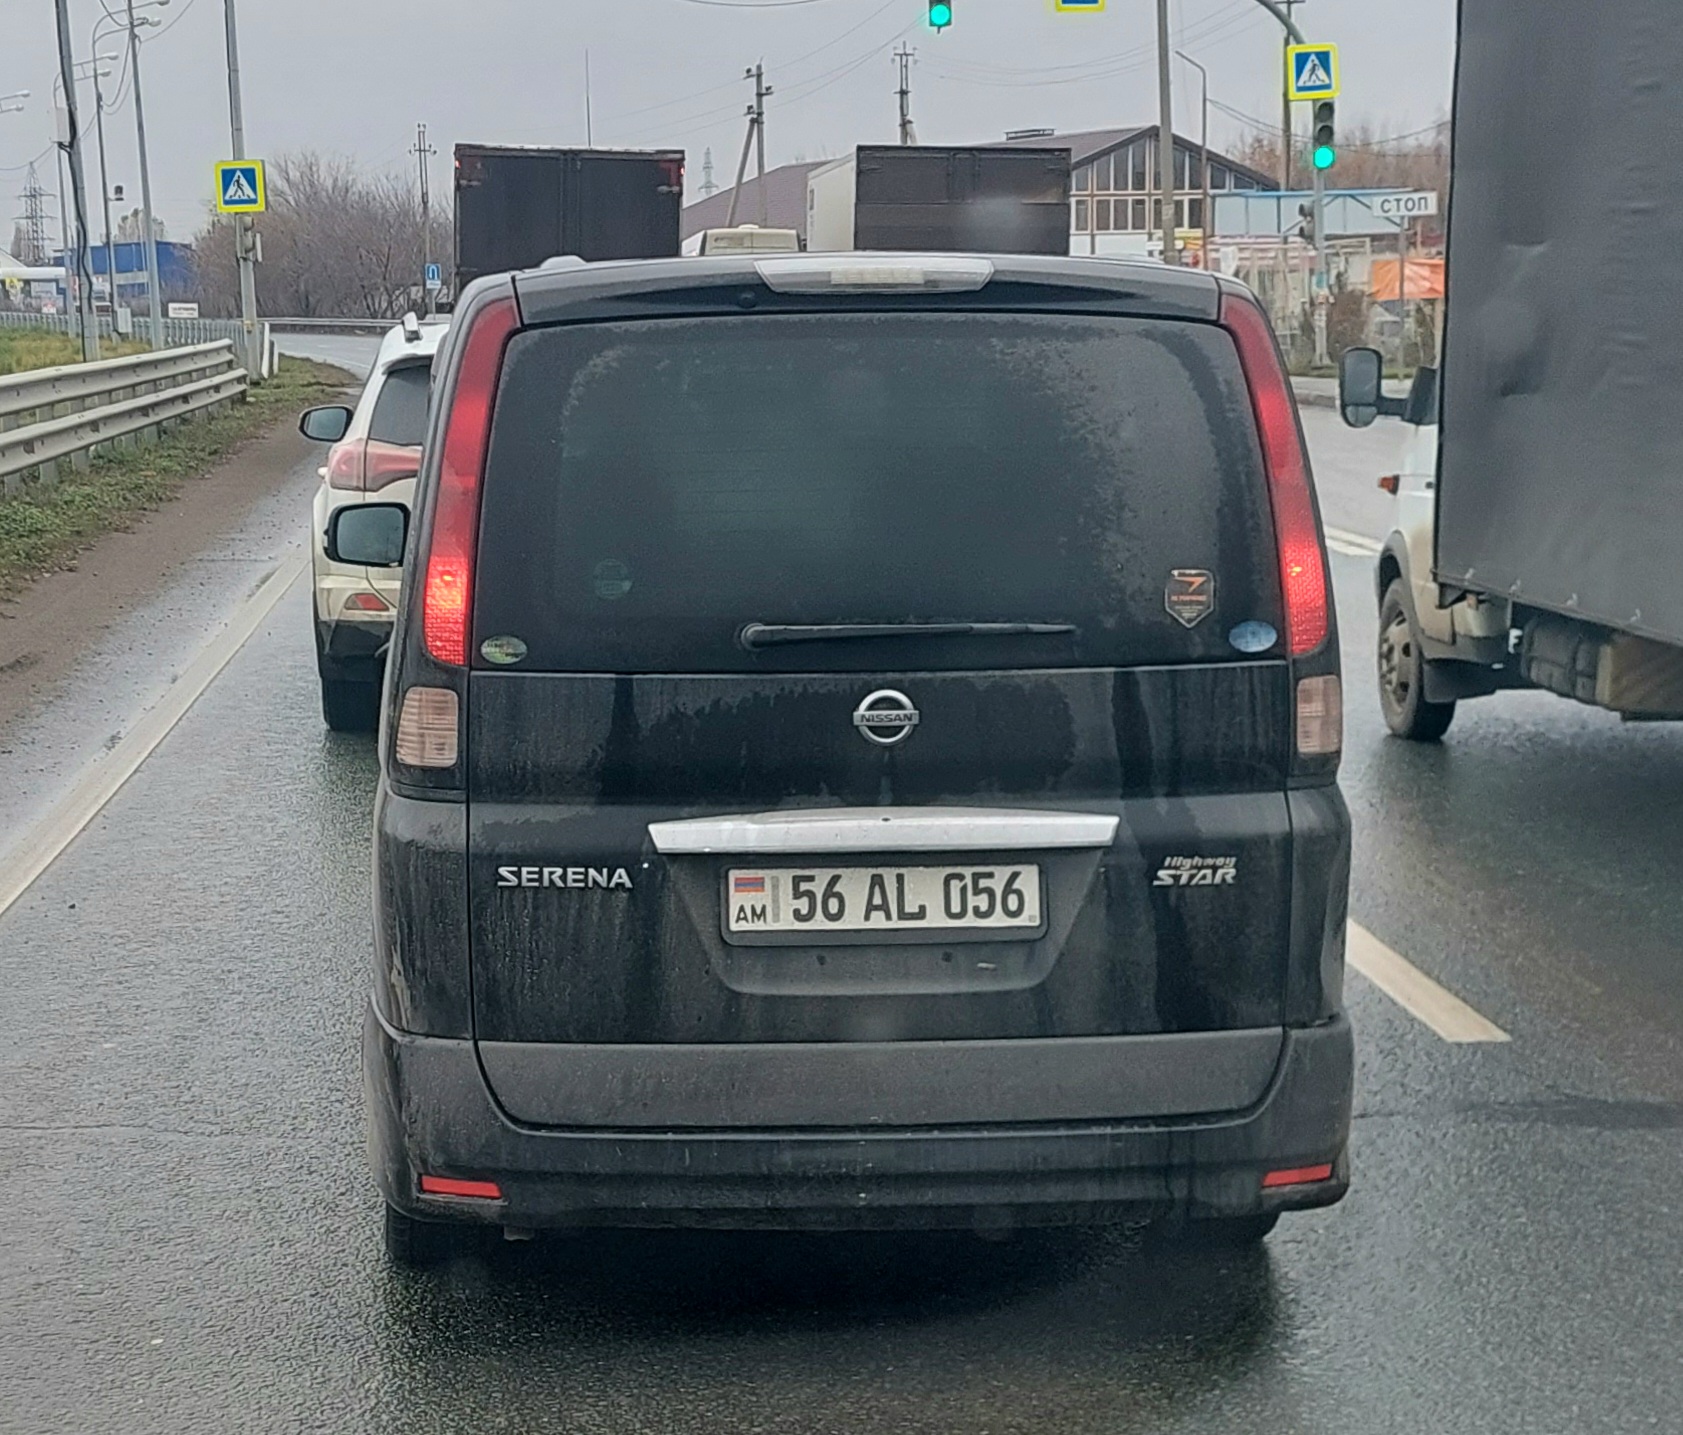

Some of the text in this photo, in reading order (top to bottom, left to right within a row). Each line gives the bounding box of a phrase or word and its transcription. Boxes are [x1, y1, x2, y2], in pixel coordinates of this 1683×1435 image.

[1380, 197, 1428, 214] СТОП
[860, 713, 913, 723] NISSAN
[1164, 856, 1237, 871] Highway
[497, 866, 633, 889] SERENA
[1152, 868, 1237, 886] STAR
[791, 871, 1026, 924] 56 AL 056
[734, 903, 767, 924] AM
